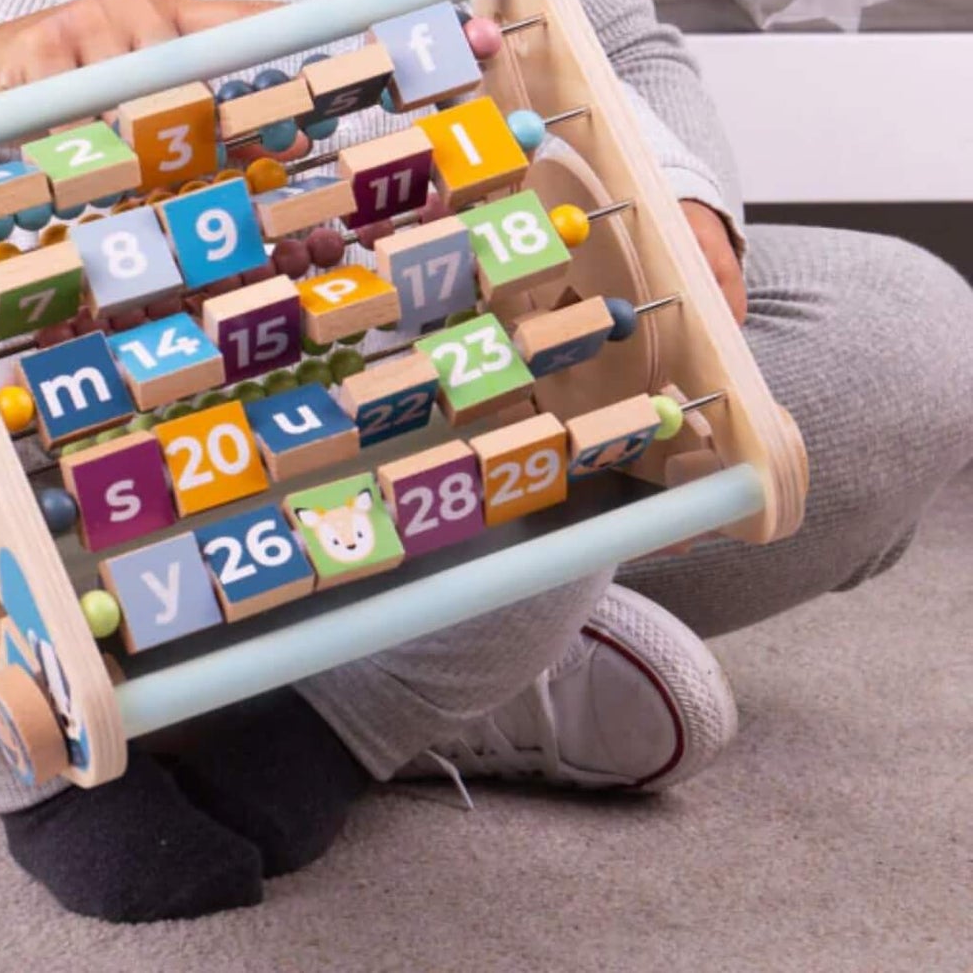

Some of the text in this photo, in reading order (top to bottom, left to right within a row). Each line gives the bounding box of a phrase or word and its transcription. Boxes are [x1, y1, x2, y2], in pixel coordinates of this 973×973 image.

[408, 22, 437, 72] f
[55, 138, 105, 167] 2
[157, 124, 193, 171] 3
[369, 169, 413, 210] 11
[101, 231, 147, 278] 8
[195, 208, 238, 261] 9
[473, 210, 549, 265] 18
[19, 288, 56, 322] 7
[402, 250, 462, 309] 17
[119, 327, 201, 369] 14
[228, 316, 289, 368] 15
[431, 326, 512, 387] 23
[39, 366, 112, 418] m
[361, 392, 429, 428] 22
[273, 404, 323, 434] u
[167, 423, 250, 491] 20
[489, 448, 560, 507] 29
[105, 479, 141, 522] s
[399, 472, 478, 538] 28
[204, 520, 293, 585] 26
[141, 560, 179, 625] y
